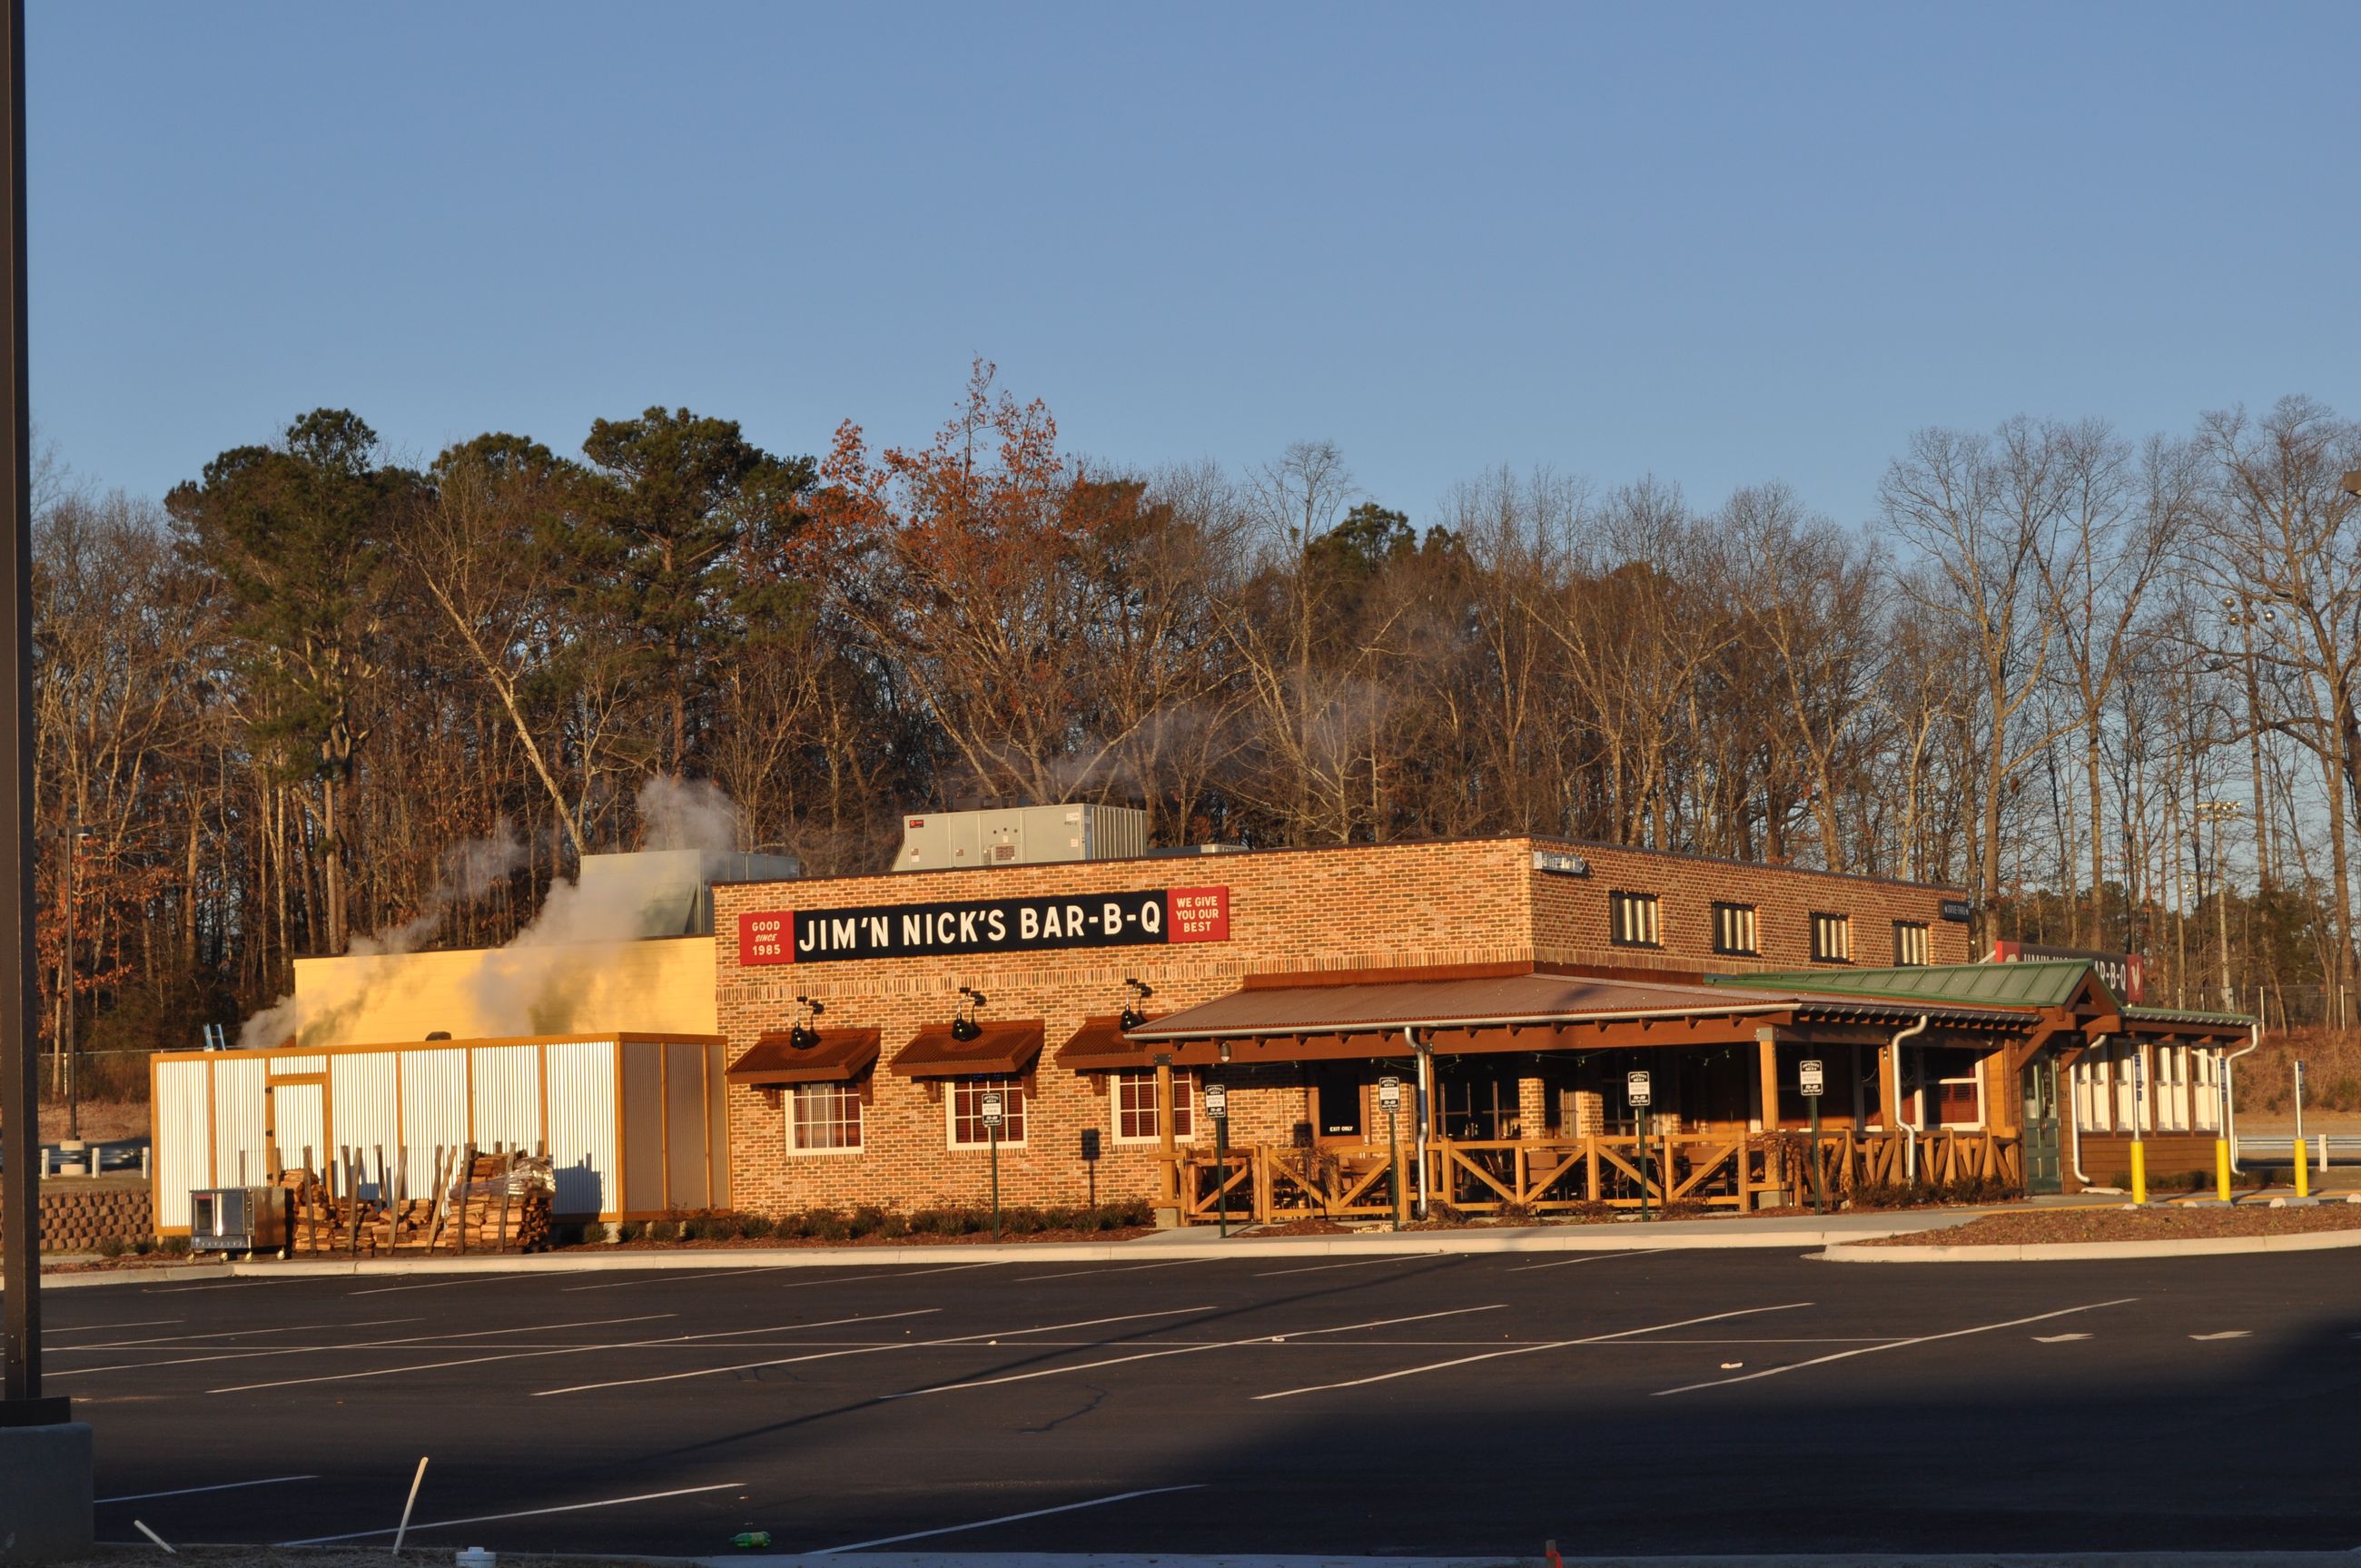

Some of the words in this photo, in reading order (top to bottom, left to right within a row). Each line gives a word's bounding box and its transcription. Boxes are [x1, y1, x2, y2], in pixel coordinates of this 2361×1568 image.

[1176, 897, 1192, 908] WE
[1194, 896, 1218, 907] GIVE
[1176, 910, 1196, 921] YOU
[1198, 908, 1219, 920] OUR
[752, 921, 781, 932] GOOD
[799, 916, 889, 952] JIM'N
[903, 909, 1006, 946] NICK'S
[1021, 901, 1161, 940] BAR-B-Q
[1183, 922, 1211, 932] BEST
[755, 933, 777, 942] SINCE
[752, 944, 781, 956] 1985
